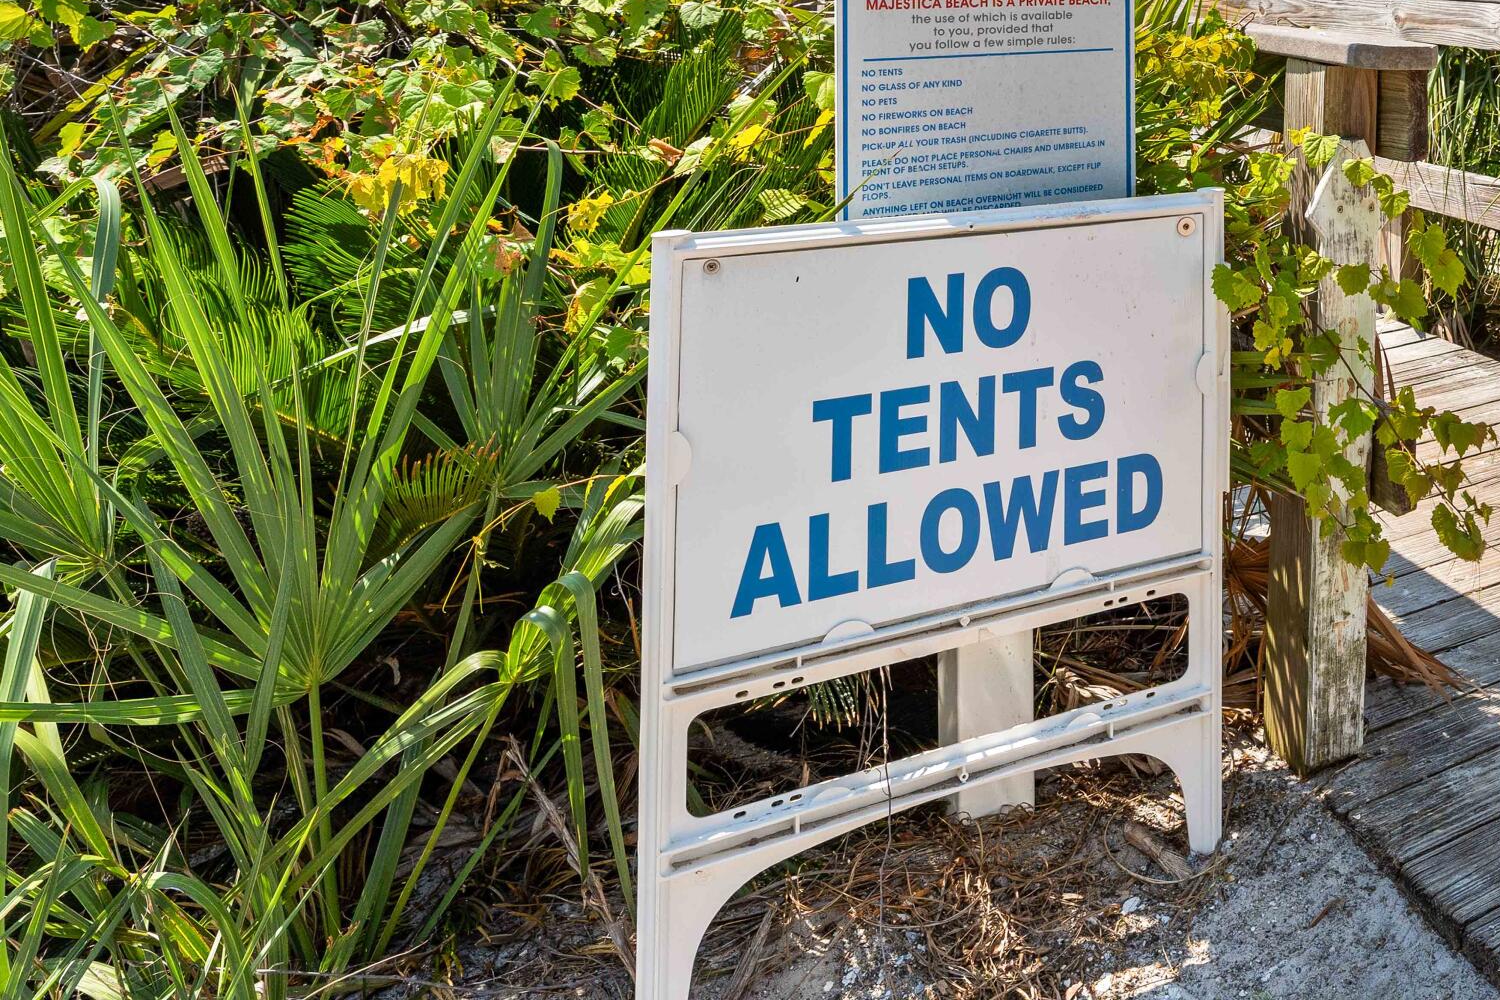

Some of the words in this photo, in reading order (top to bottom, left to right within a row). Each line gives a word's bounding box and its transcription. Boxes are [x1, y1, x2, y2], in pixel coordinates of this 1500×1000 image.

[912, 14, 931, 24] the
[935, 15, 954, 23] use
[958, 13, 970, 23] of
[973, 12, 1006, 22] which
[1009, 11, 1018, 21] is
[1021, 10, 1073, 21] available
[933, 27, 945, 36] to
[948, 28, 974, 39] you,
[977, 24, 1028, 37] provided
[1031, 23, 1053, 33] that
[909, 42, 932, 52] you
[935, 38, 969, 50] follow
[973, 40, 981, 48] a
[984, 37, 1004, 48] few
[1007, 36, 1043, 49] simple
[1046, 35, 1076, 46] rules:
[861, 69, 876, 77] NO
[879, 68, 903, 76] TENTS
[861, 84, 876, 92] NO
[879, 82, 906, 91] GLASS
[908, 81, 920, 89] OF
[923, 81, 940, 89] ANY
[942, 79, 963, 88] KIND
[861, 99, 876, 107] NO
[878, 98, 897, 106] PETS
[879, 110, 927, 120] FIREWORKS
[929, 109, 943, 117] ON
[945, 107, 973, 116] BEACH
[861, 128, 876, 136] NO
[879, 125, 920, 135] BONFIRES
[922, 124, 936, 132] ON
[938, 122, 966, 131] BEACH
[861, 141, 896, 151] PICK-UP
[897, 140, 914, 148] ALL
[916, 138, 939, 147] YOUR
[941, 136, 967, 145] TRASH
[968, 132, 1017, 143] (INCLUDING
[1019, 128, 1061, 139] CIGARETTE
[1063, 126, 1088, 135] BUTTS).
[861, 158, 892, 167] PLEASE
[894, 157, 909, 165] DO
[911, 155, 929, 163] NOT
[931, 152, 957, 162] PLACE
[960, 149, 1001, 159] PERSONAL
[1003, 145, 1033, 155] CHAIRS
[1034, 144, 1051, 152] AND
[1053, 140, 1096, 151] UMBRELLAS
[861, 167, 890, 177] FRONT
[893, 166, 906, 174] OF
[907, 164, 936, 173] BEACH
[938, 160, 968, 170] SETUPS.
[861, 182, 890, 192] DON'T
[892, 180, 917, 189] LEAVE
[920, 176, 963, 186] PERSONAL
[964, 173, 988, 182] ITEMS
[989, 171, 1003, 179] ON
[1004, 166, 1056, 178] BOARDWALK,
[1057, 163, 1085, 173] EXCEPT
[1086, 162, 1101, 170] FLIP
[862, 192, 892, 201] FLOPS.
[862, 204, 908, 216] ANYTHING
[909, 202, 928, 211] LEFT
[930, 200, 944, 209] ON
[946, 197, 974, 207] BEACH
[975, 192, 1022, 204] OVERNIGHT
[1024, 190, 1042, 198] WILL
[1043, 189, 1052, 197] BE
[1054, 183, 1104, 195] CONSIDERED
[906, 265, 1031, 360] NO
[812, 360, 1106, 484] TENTS
[730, 453, 1163, 619] ALLOWED
